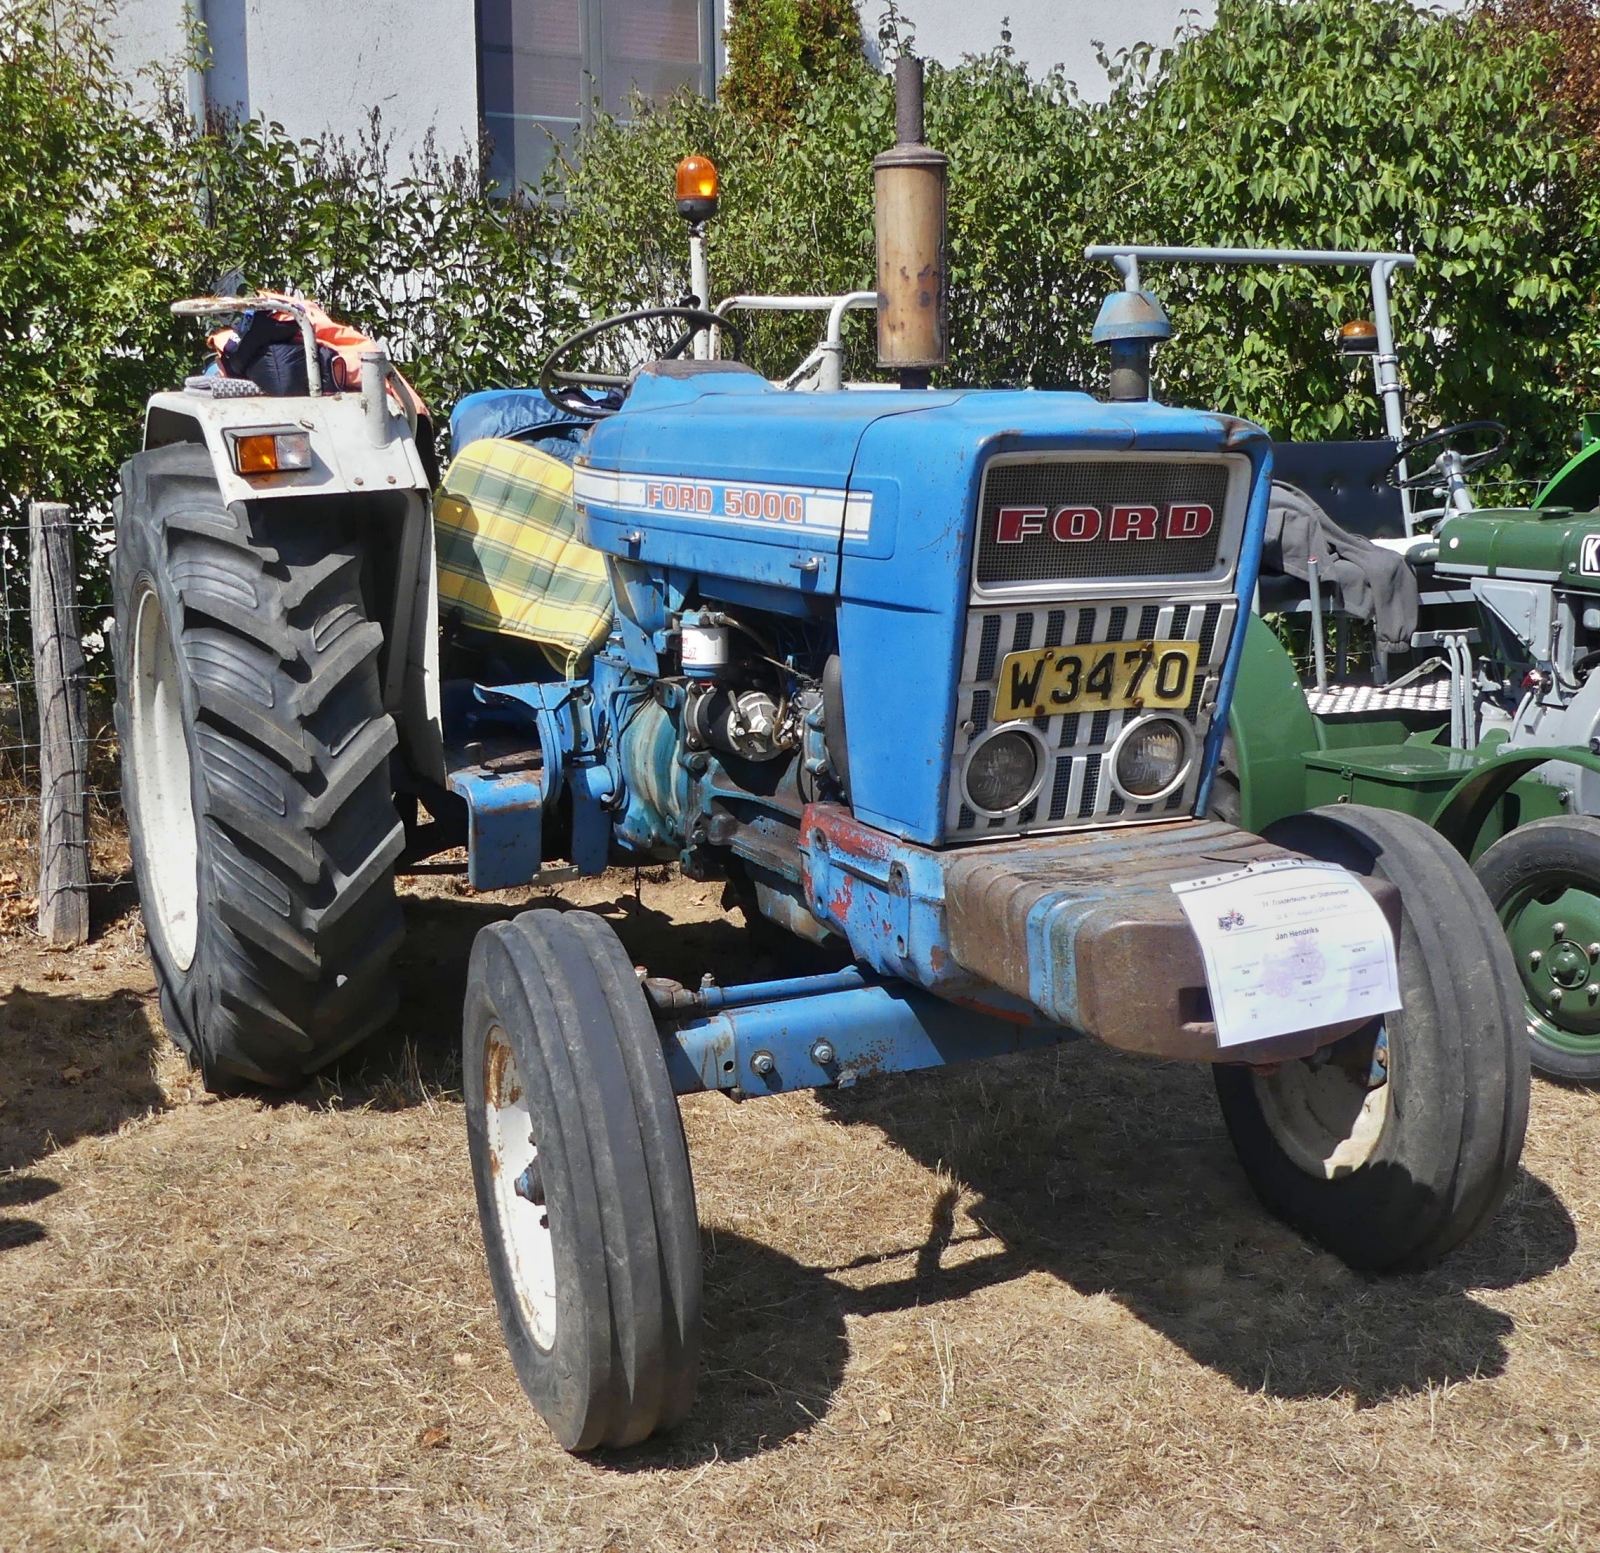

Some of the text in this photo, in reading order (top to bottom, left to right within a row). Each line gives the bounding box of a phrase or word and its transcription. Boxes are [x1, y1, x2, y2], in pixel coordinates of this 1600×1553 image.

[648, 483, 803, 523] FORD 5000
[994, 503, 1213, 543] FORD
[1010, 650, 1189, 710] W3470
[1275, 926, 1320, 941] Jan Hendriks
